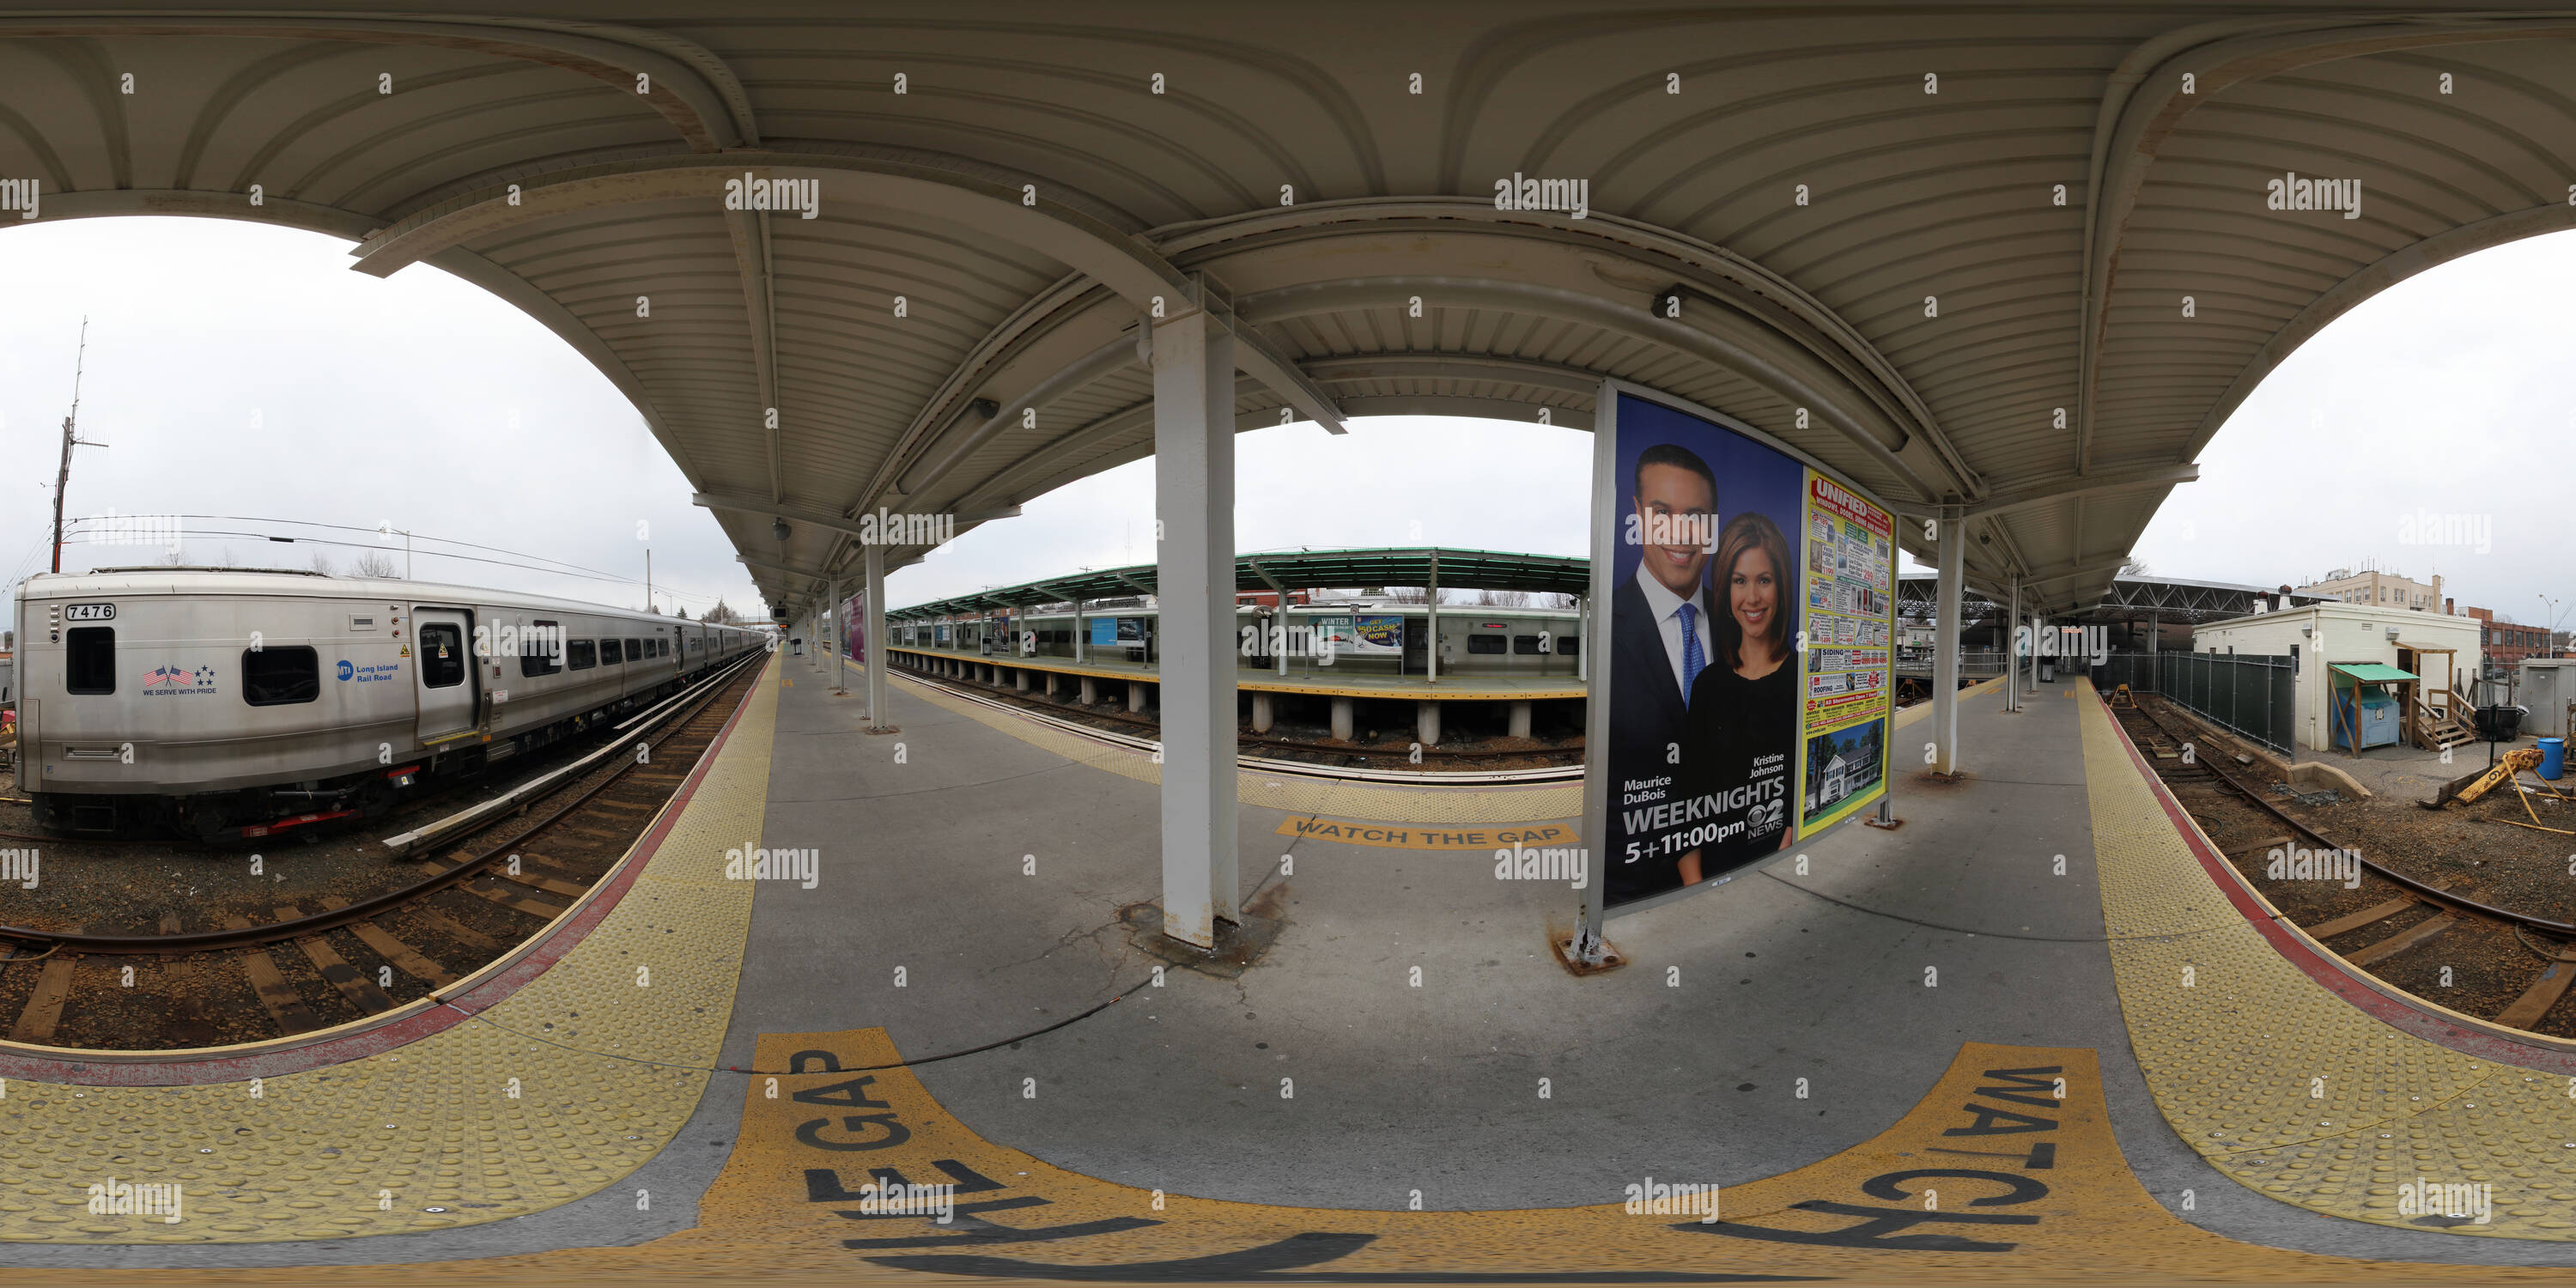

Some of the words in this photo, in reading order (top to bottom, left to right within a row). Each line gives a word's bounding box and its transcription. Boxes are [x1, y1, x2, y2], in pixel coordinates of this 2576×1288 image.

[1816, 477, 1868, 517] UNIFIED
[70, 605, 112, 618] 7476
[1321, 617, 1349, 626] WINTER
[1373, 623, 1395, 633] CASH
[356, 665, 375, 675] Long
[376, 663, 398, 672] Island
[357, 674, 372, 683] Rail
[374, 673, 392, 682] Road
[1814, 685, 1833, 694] ROOFING
[1753, 752, 1784, 768] Kristine
[1749, 762, 1783, 780] Johnson
[1624, 775, 1672, 793] Maurice
[1622, 775, 1785, 835] WEEKNIGHTS
[1623, 789, 1666, 805] DuBois
[1296, 820, 1407, 844] WATCH
[1420, 831, 1487, 845] THE
[1497, 828, 1561, 843] GAP
[1747, 818, 1783, 840] NEWS
[788, 1048, 912, 1152] GAP
[1668, 1065, 2064, 1254] WATCH
